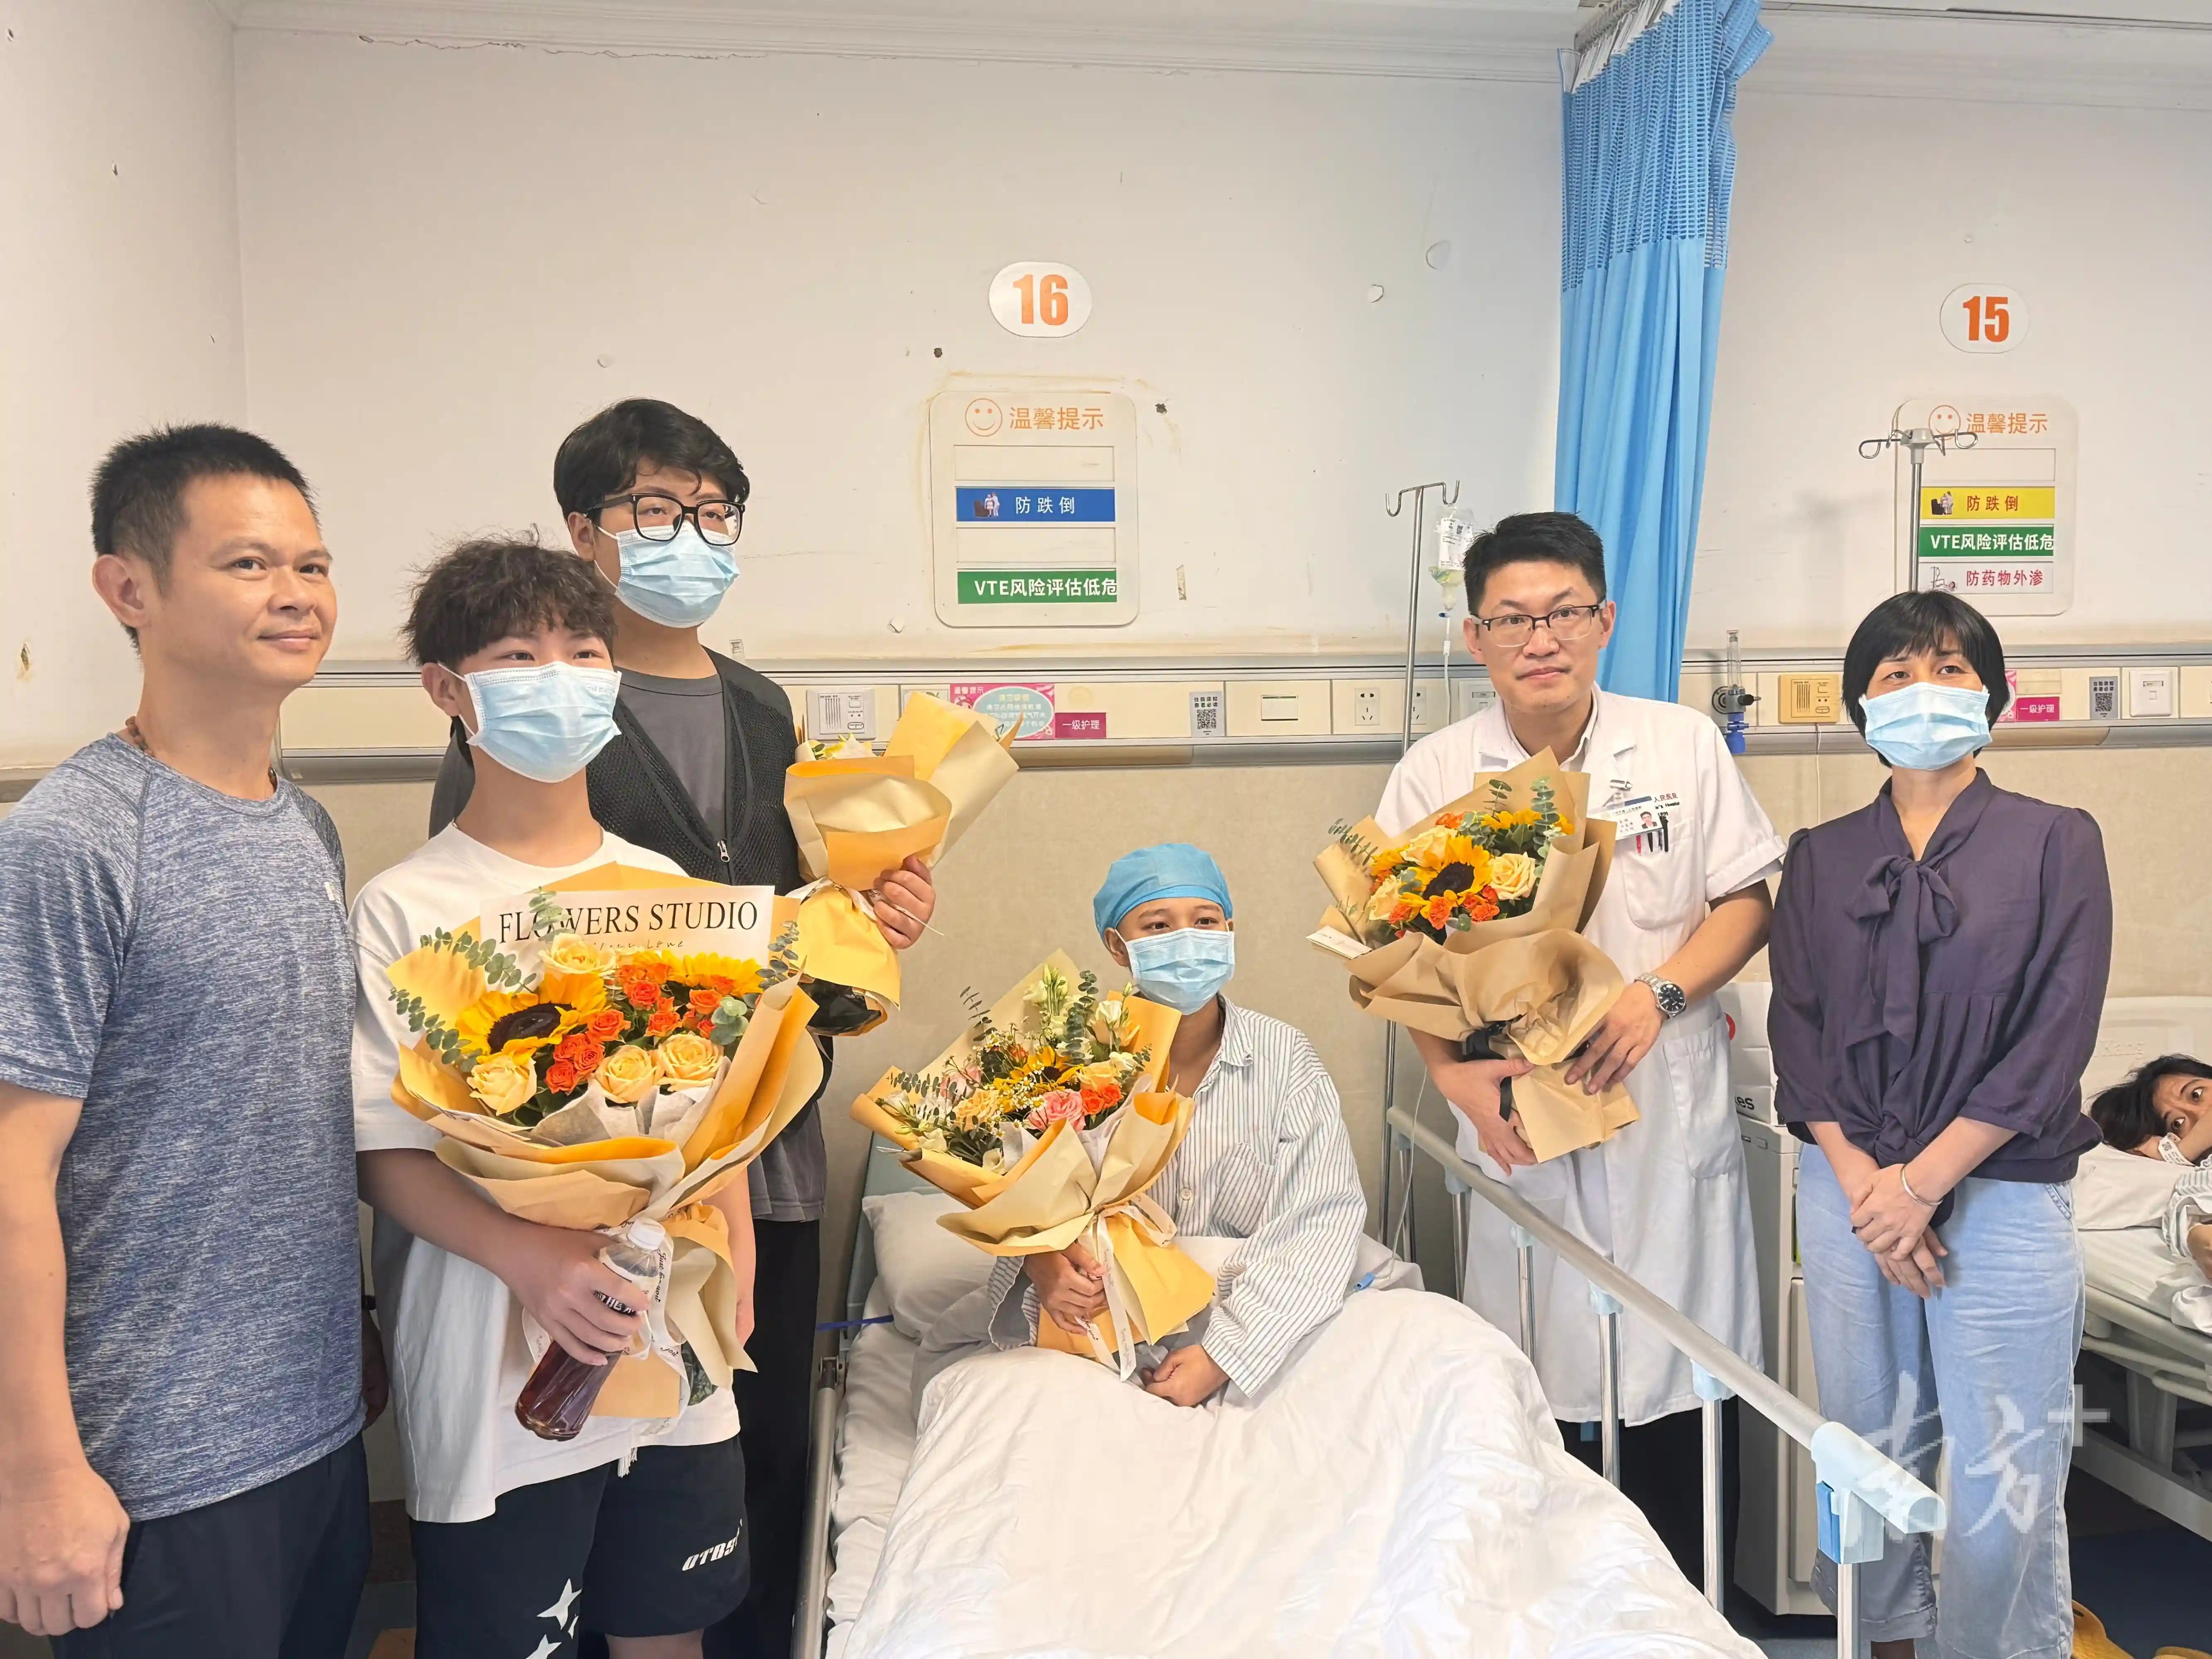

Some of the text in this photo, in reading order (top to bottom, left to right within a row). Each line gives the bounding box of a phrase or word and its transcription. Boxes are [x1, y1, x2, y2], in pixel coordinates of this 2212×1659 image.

[1012, 274, 1069, 326] 16
[1963, 295, 2010, 343] 15
[1010, 406, 1104, 431] 温馨提示
[1966, 413, 2048, 435] 温馨提示
[1015, 496, 1075, 514] 防跌倒
[1967, 495, 2019, 512] 防跌倒
[1930, 534, 2054, 551] VTE风险评估低危
[974, 577, 1117, 597] VTE风险评估低危
[1966, 570, 2043, 586] 防药物外渗
[2020, 704, 2055, 713] 一级护理
[1062, 720, 1100, 730] 一级护理
[649, 901, 758, 931] STUDIO
